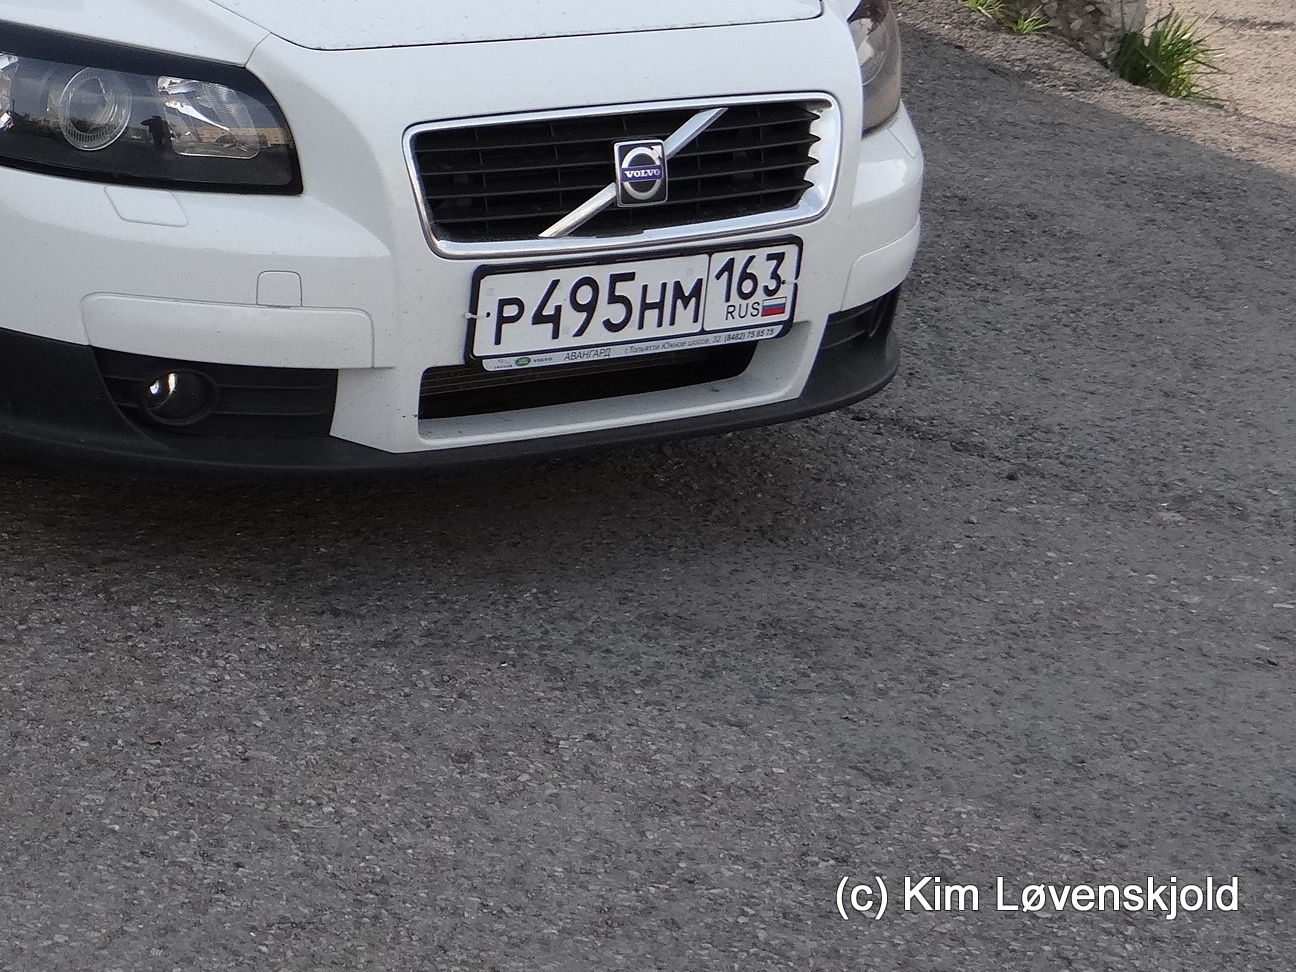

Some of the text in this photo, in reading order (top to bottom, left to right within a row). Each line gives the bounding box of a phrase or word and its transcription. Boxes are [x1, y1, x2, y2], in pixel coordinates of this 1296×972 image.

[624, 169, 661, 178] VOLVO
[714, 252, 786, 303] 163
[725, 301, 761, 320] RUS
[564, 348, 612, 361] АВАНГАРД
